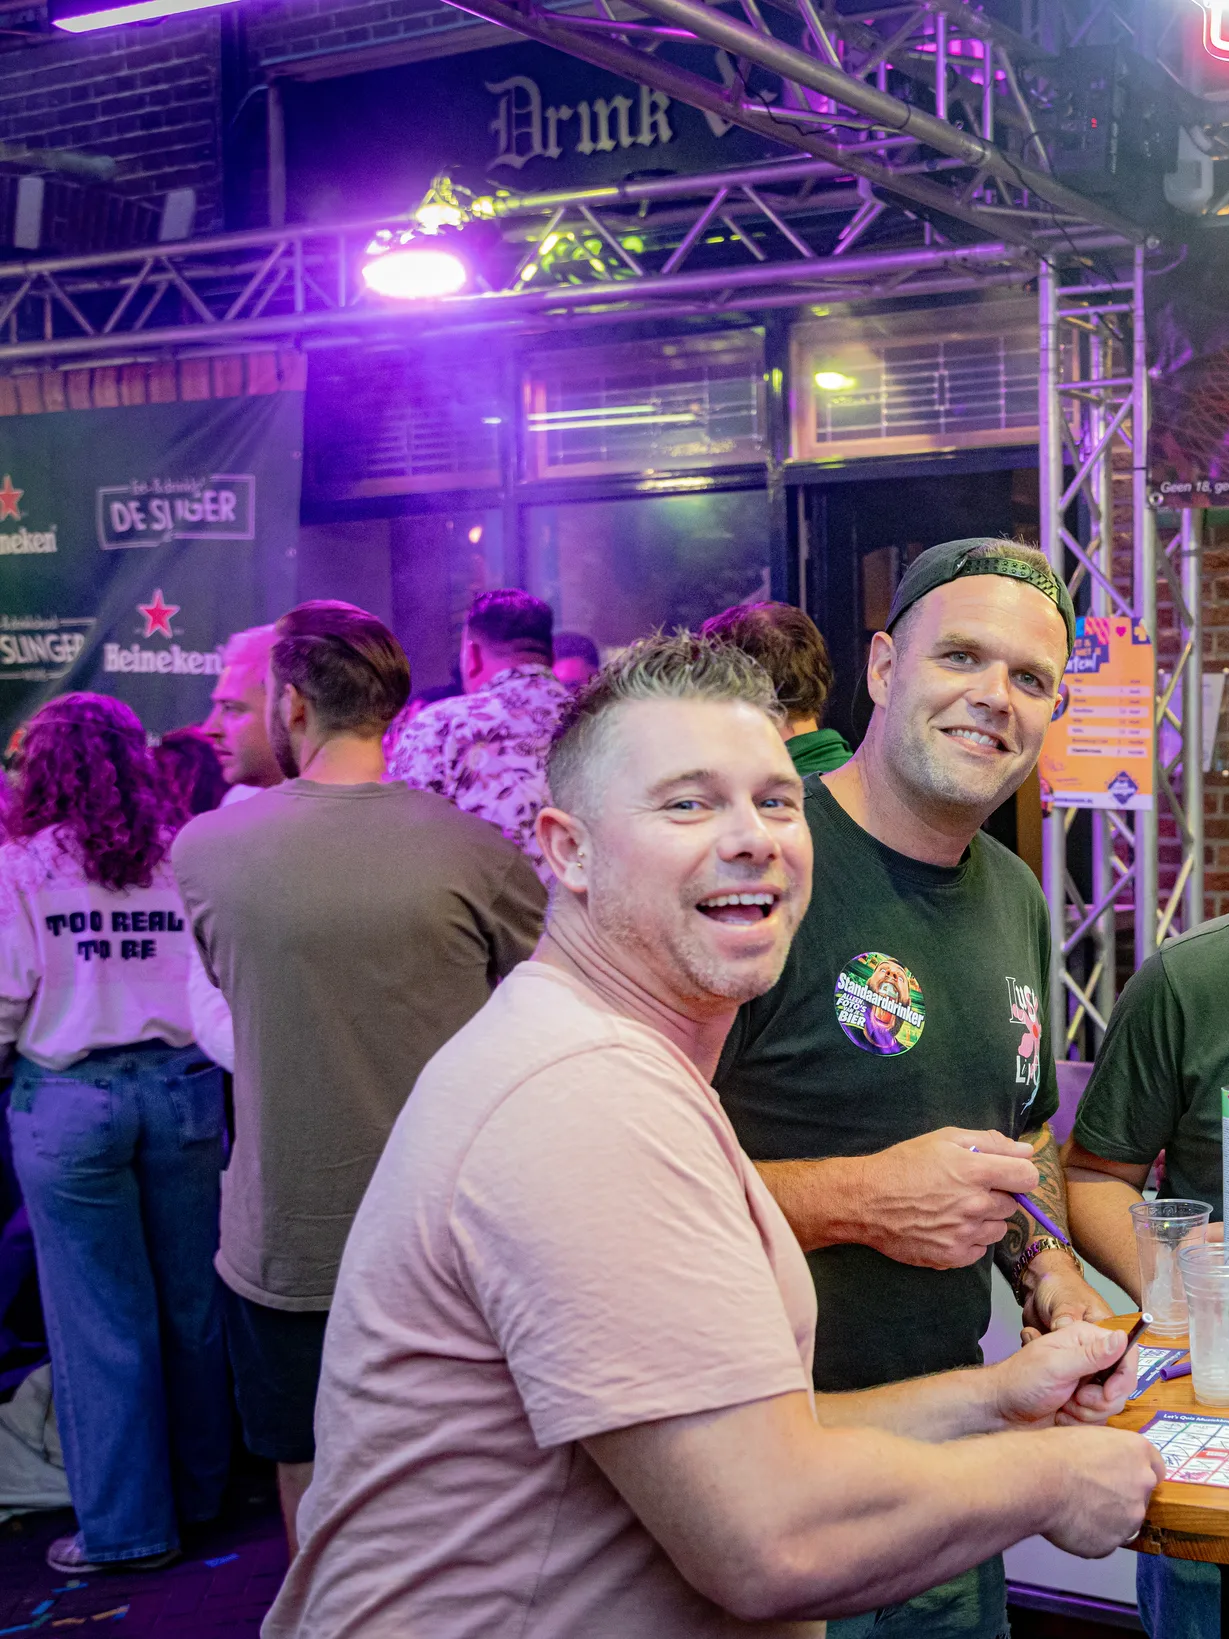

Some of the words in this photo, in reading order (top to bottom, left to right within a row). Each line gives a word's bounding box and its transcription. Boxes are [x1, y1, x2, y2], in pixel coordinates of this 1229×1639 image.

[484, 75, 674, 171] Drink
[1160, 481, 1193, 494] Geen
[103, 643, 224, 676] Heineken
[46, 911, 103, 937] TOO
[111, 911, 184, 933] REAL
[77, 939, 111, 961] TO
[120, 939, 157, 960] BE
[835, 998, 867, 1014] FOTO'S
[837, 972, 925, 1028] Standaarddrinker
[837, 1010, 867, 1028] BIER
